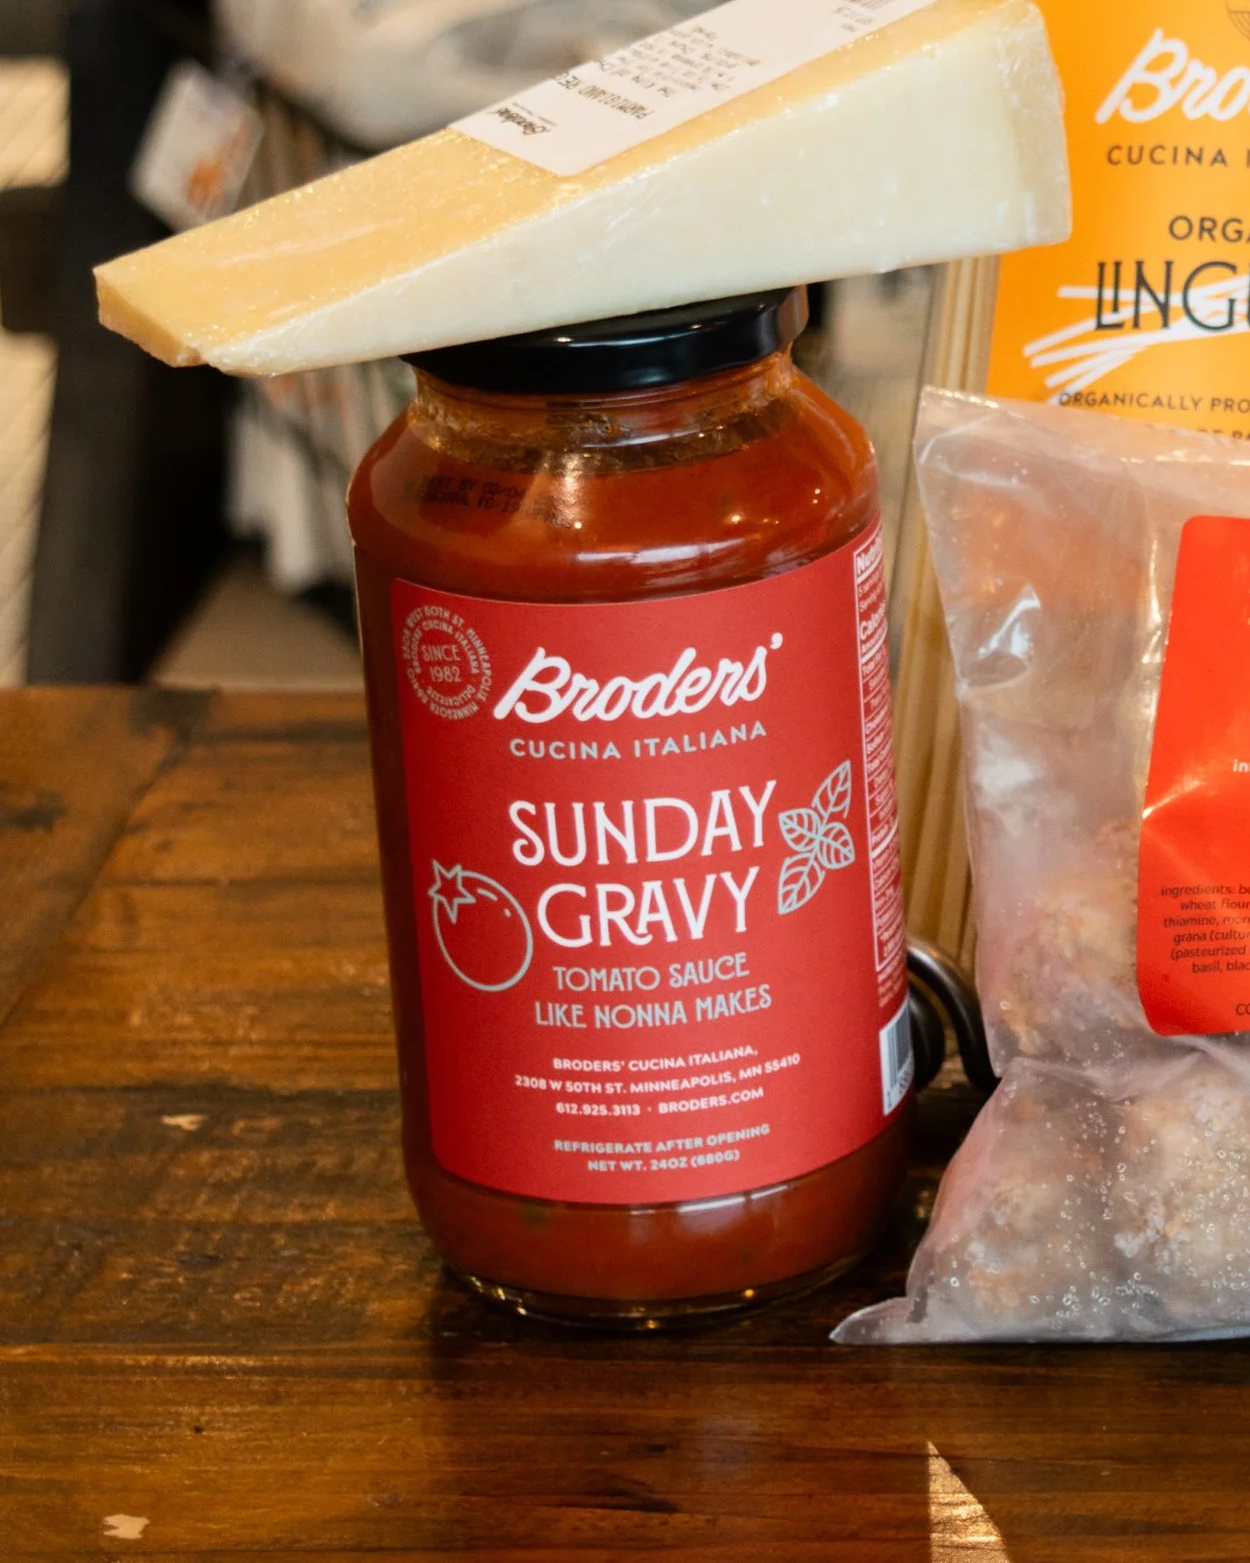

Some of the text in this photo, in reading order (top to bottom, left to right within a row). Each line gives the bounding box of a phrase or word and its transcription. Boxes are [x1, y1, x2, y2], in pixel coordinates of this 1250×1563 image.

[1107, 145, 1228, 168] CUCINA
[1058, 391, 1204, 411] ORGANICALLY
[421, 645, 460, 661] SINCE
[429, 665, 461, 682] 1982
[493, 632, 784, 725] Broders'
[509, 720, 768, 761] CUCINA ITALIANA
[508, 779, 777, 867] SUNDAY
[536, 865, 761, 949] GRAVY
[1180, 900, 1217, 911] wheat
[1163, 916, 1219, 928] thiamine,
[1173, 932, 1207, 944] grana
[1170, 945, 1246, 962] (pasteurized
[553, 952, 750, 993] TOMATO SAUCE
[1192, 961, 1223, 974] basil,
[535, 984, 773, 1029] LIKE NONNA MAKES
[552, 1045, 759, 1073] BRODERS' CUCINA ITALIANA,
[515, 1052, 801, 1095] 2308 W 50TH ST. MINNEAPOLIS, MN 55410
[555, 1087, 765, 1116] 612.925.3113 BRODERS.COM
[553, 1123, 770, 1155] REFRIGERATE AFTER OPENING
[587, 1149, 741, 1173] NET WT. 24OZ (680G)
